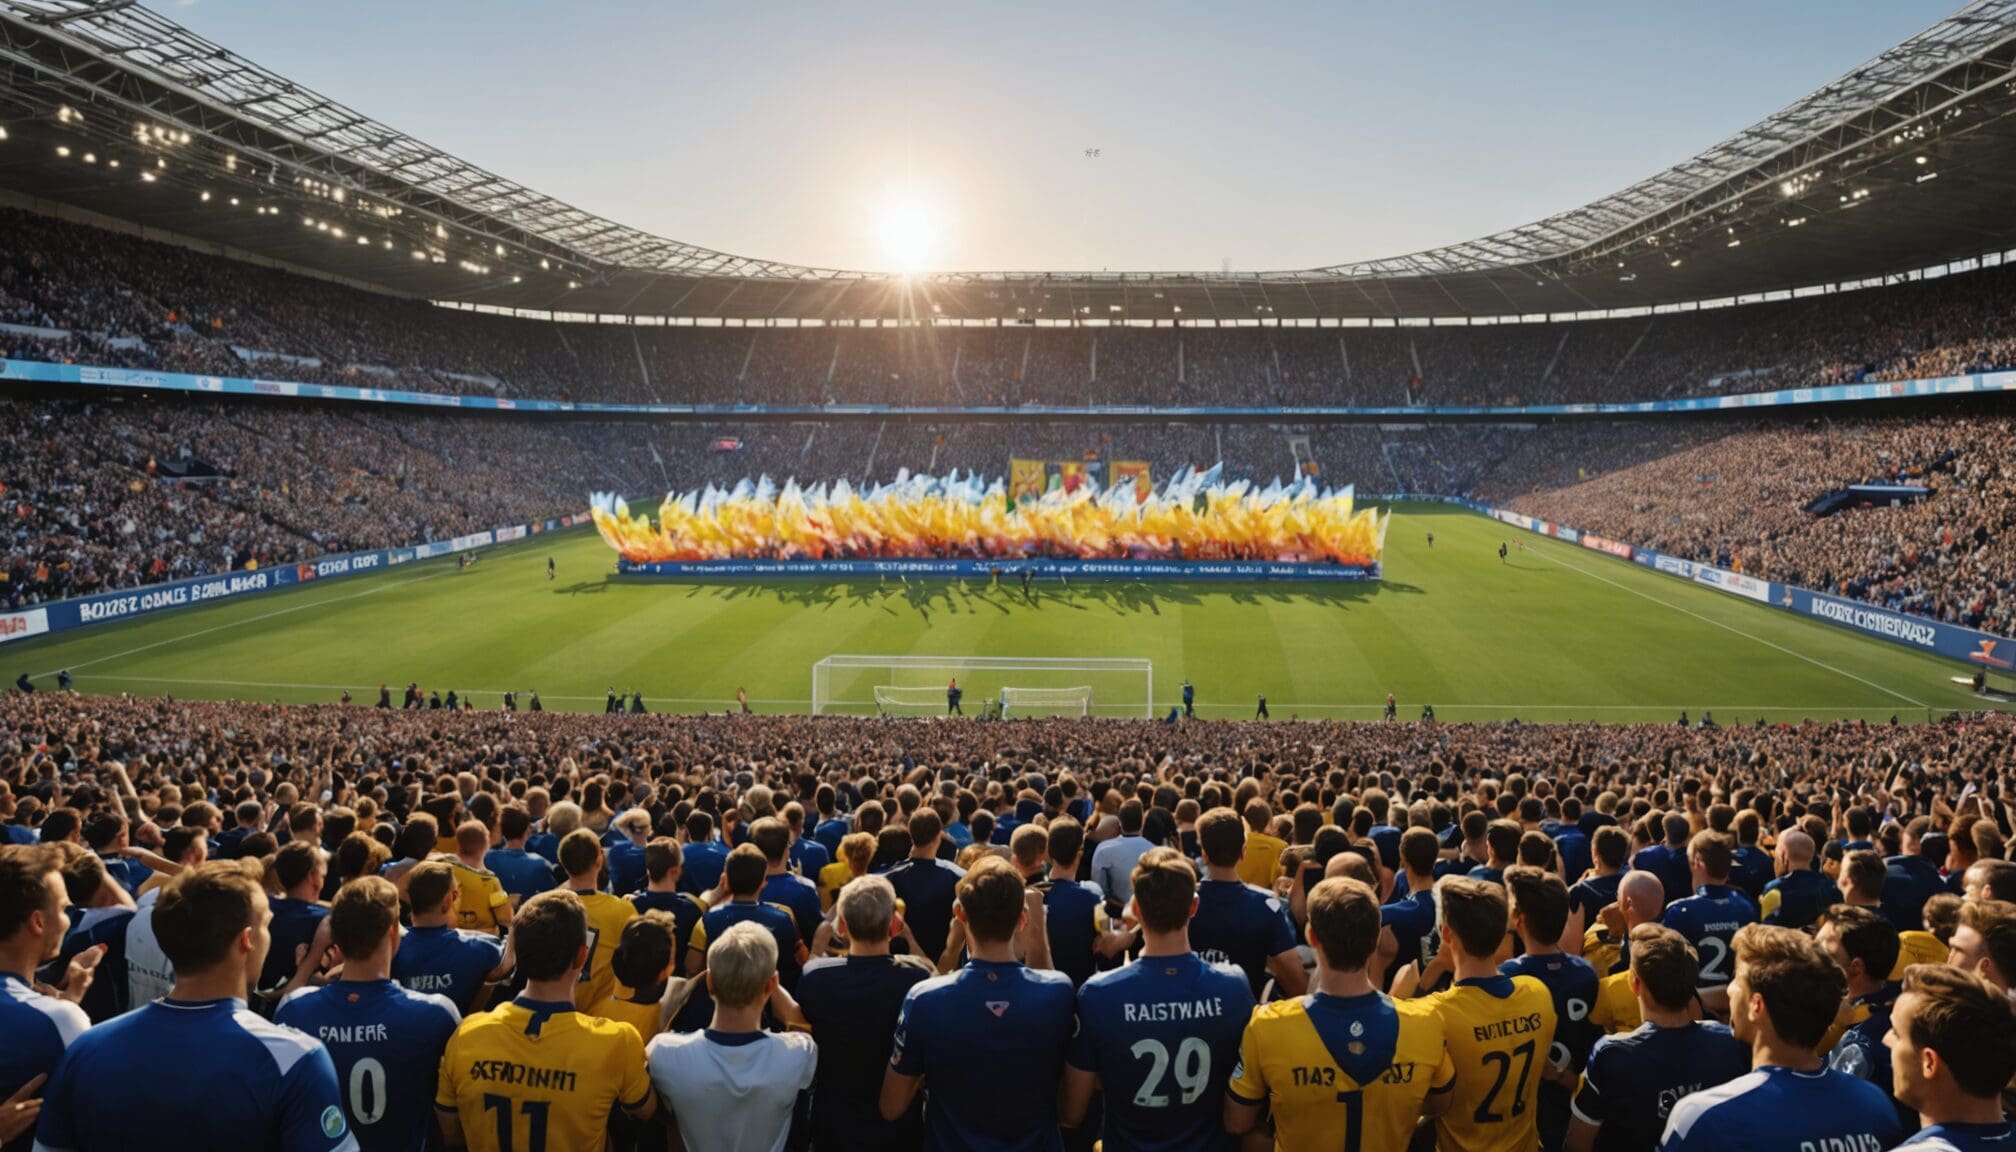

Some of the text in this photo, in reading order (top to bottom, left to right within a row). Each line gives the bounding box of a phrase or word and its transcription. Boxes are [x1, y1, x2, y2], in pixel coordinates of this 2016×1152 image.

[1698, 936, 1728, 980] 2
[1131, 1037, 1211, 1108] 29
[1474, 1040, 1536, 1123] 27
[484, 1092, 551, 1152] 11
